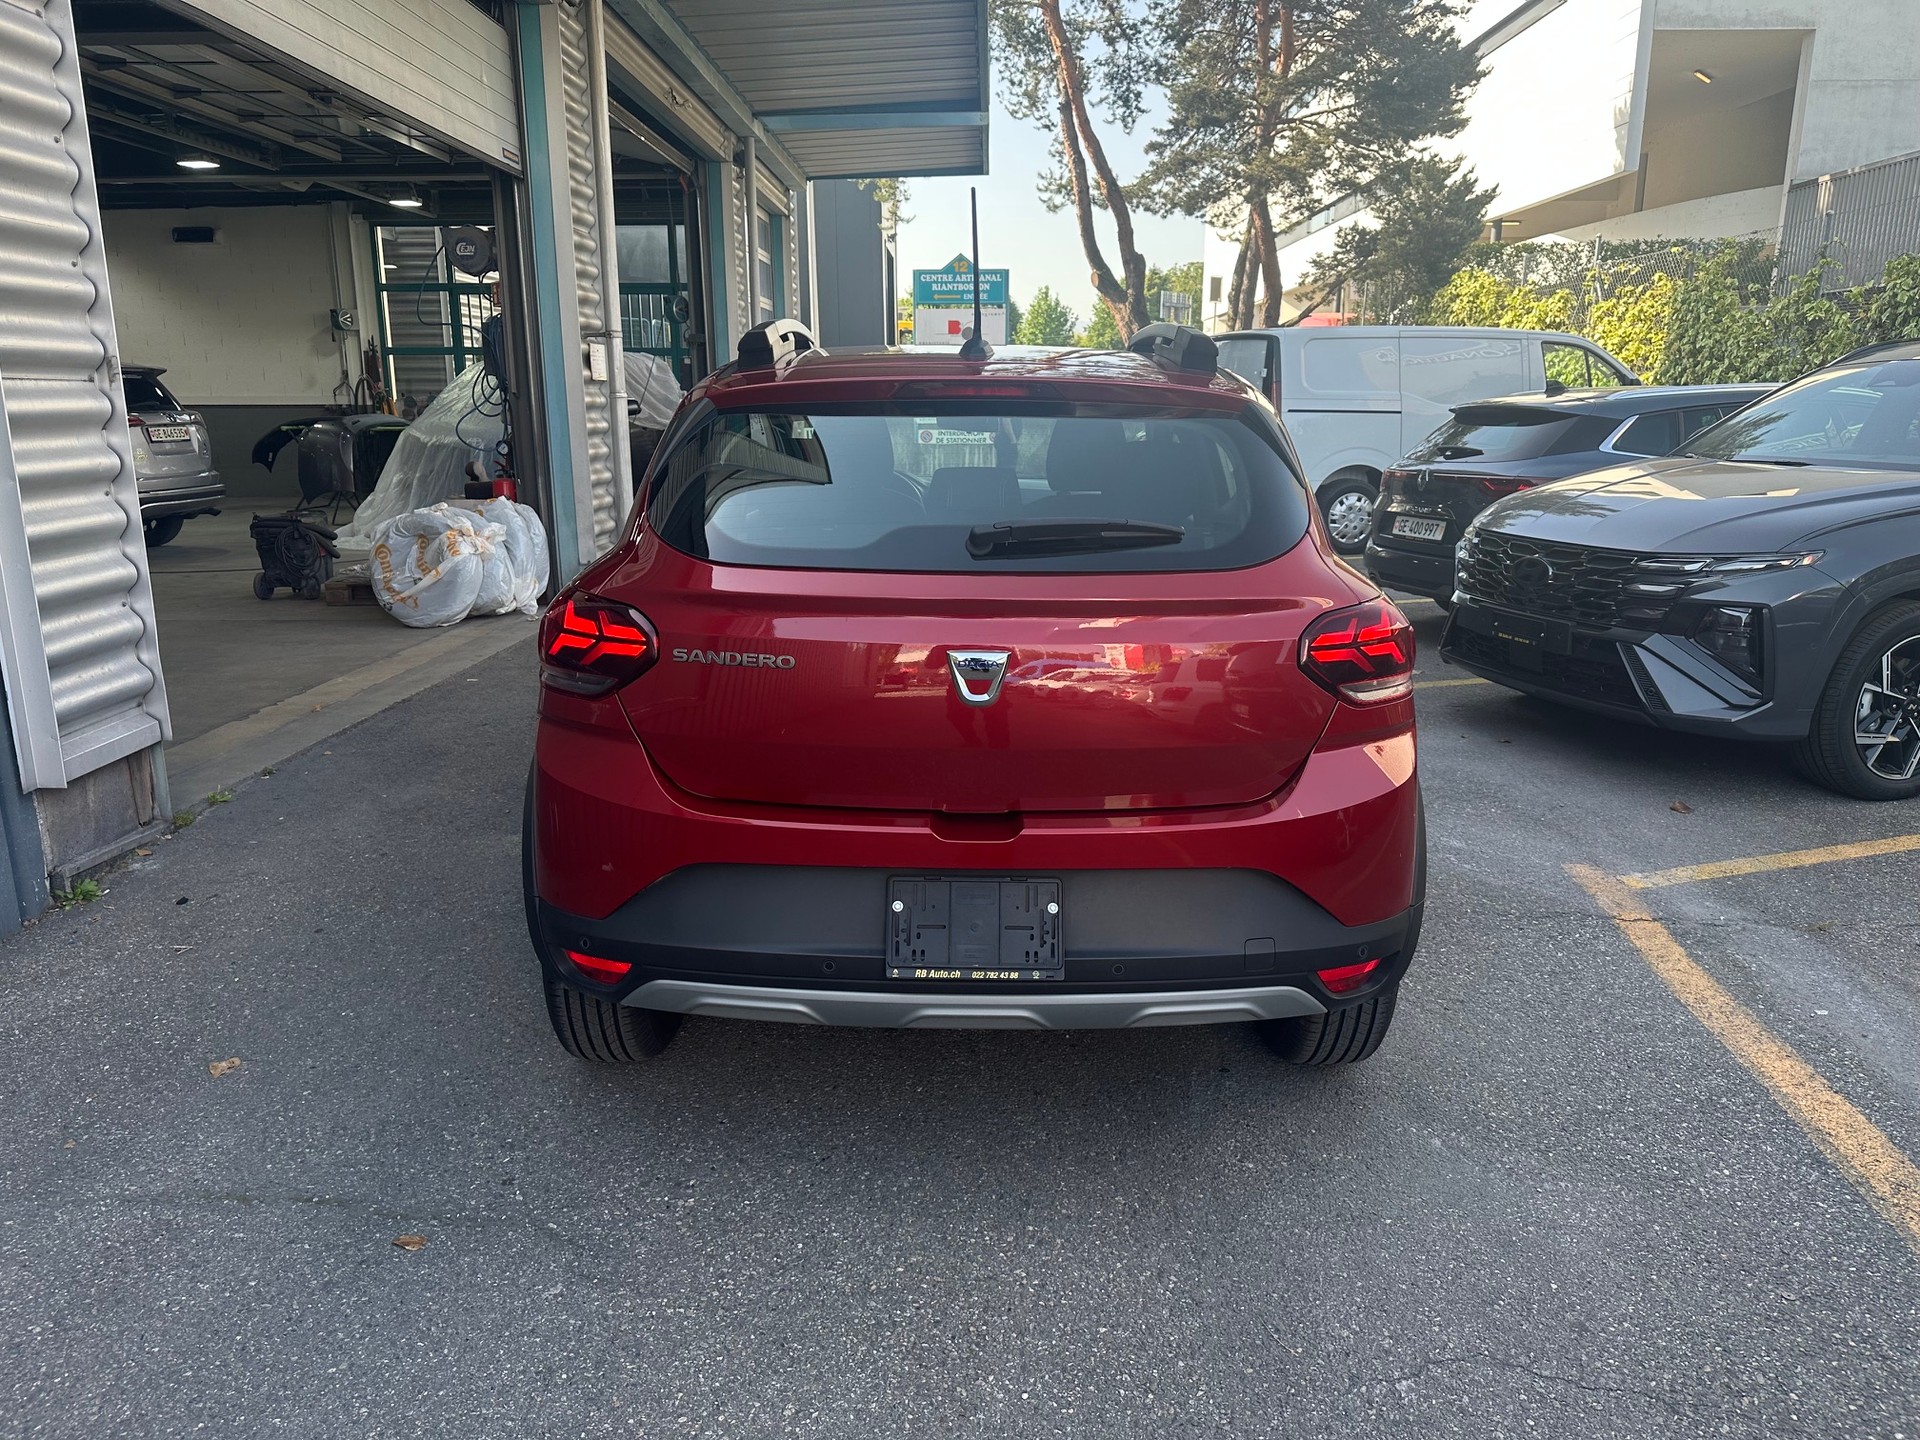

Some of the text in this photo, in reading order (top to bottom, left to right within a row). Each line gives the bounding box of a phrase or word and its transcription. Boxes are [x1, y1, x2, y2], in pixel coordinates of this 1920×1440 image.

[953, 261, 968, 272] 12
[920, 274, 1002, 282] CENTRE ARTIANAL
[932, 283, 990, 291] RIANTBOSON
[963, 292, 988, 300] ENÉE
[672, 648, 796, 669] SANDERO
[957, 660, 1000, 669] DACIA
[915, 969, 927, 978] RB
[929, 969, 961, 978] Auto.ch
[971, 971, 985, 979] 022
[986, 971, 999, 979] 782
[1000, 971, 1009, 979] 43
